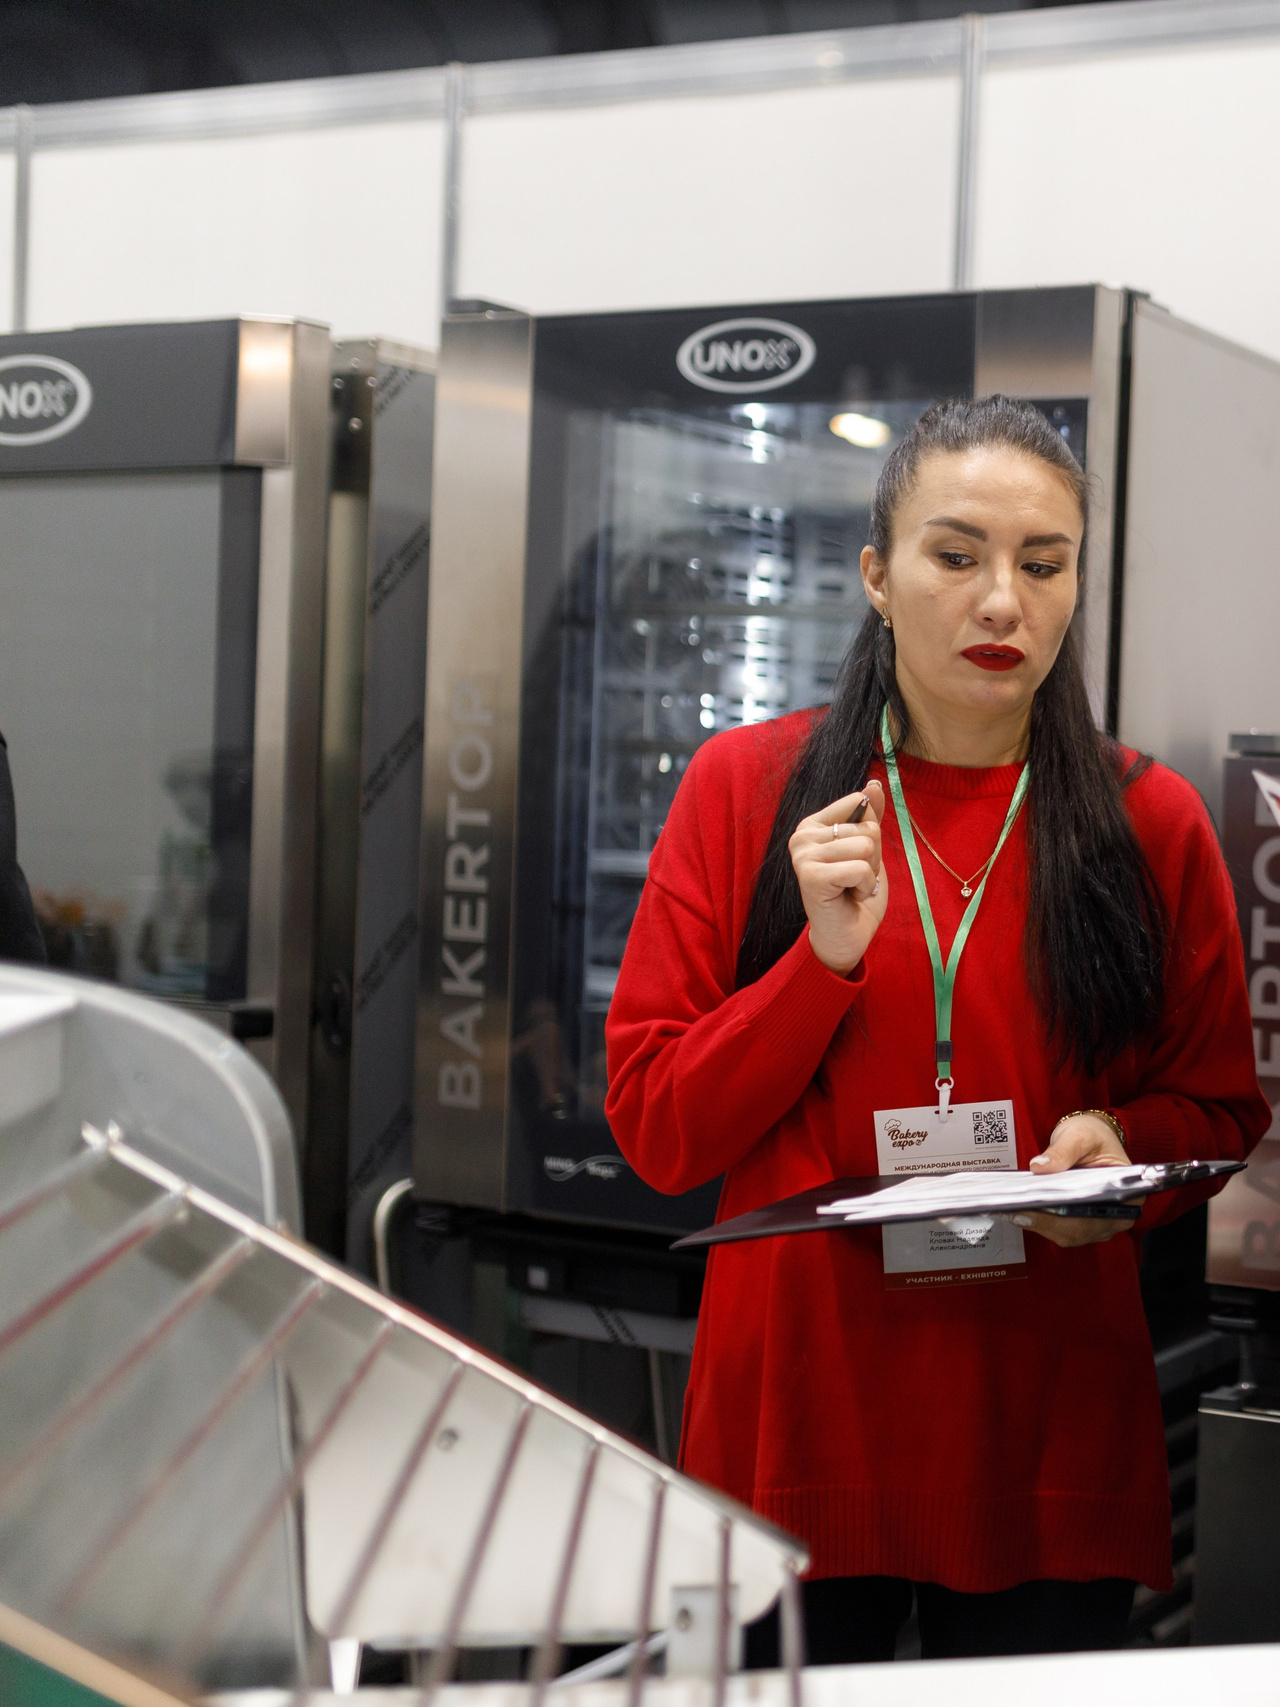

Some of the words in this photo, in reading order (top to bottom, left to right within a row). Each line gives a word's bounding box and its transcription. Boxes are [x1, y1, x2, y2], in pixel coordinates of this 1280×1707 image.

[693, 338, 791, 373] UNOX
[0, 380, 67, 420] NOX
[438, 681, 494, 1111] BAKERTOP
[888, 1129, 928, 1141] Bakery
[892, 1139, 915, 1150] expo
[894, 1161, 961, 1172] МЕЖДУНАРОДНАЯ
[962, 1158, 1001, 1167] ВЫСТАВКА
[929, 1243, 986, 1251] Александровна
[906, 1275, 953, 1284] УЧАСТНИК
[960, 1270, 1007, 1280] EXHIBITOR
